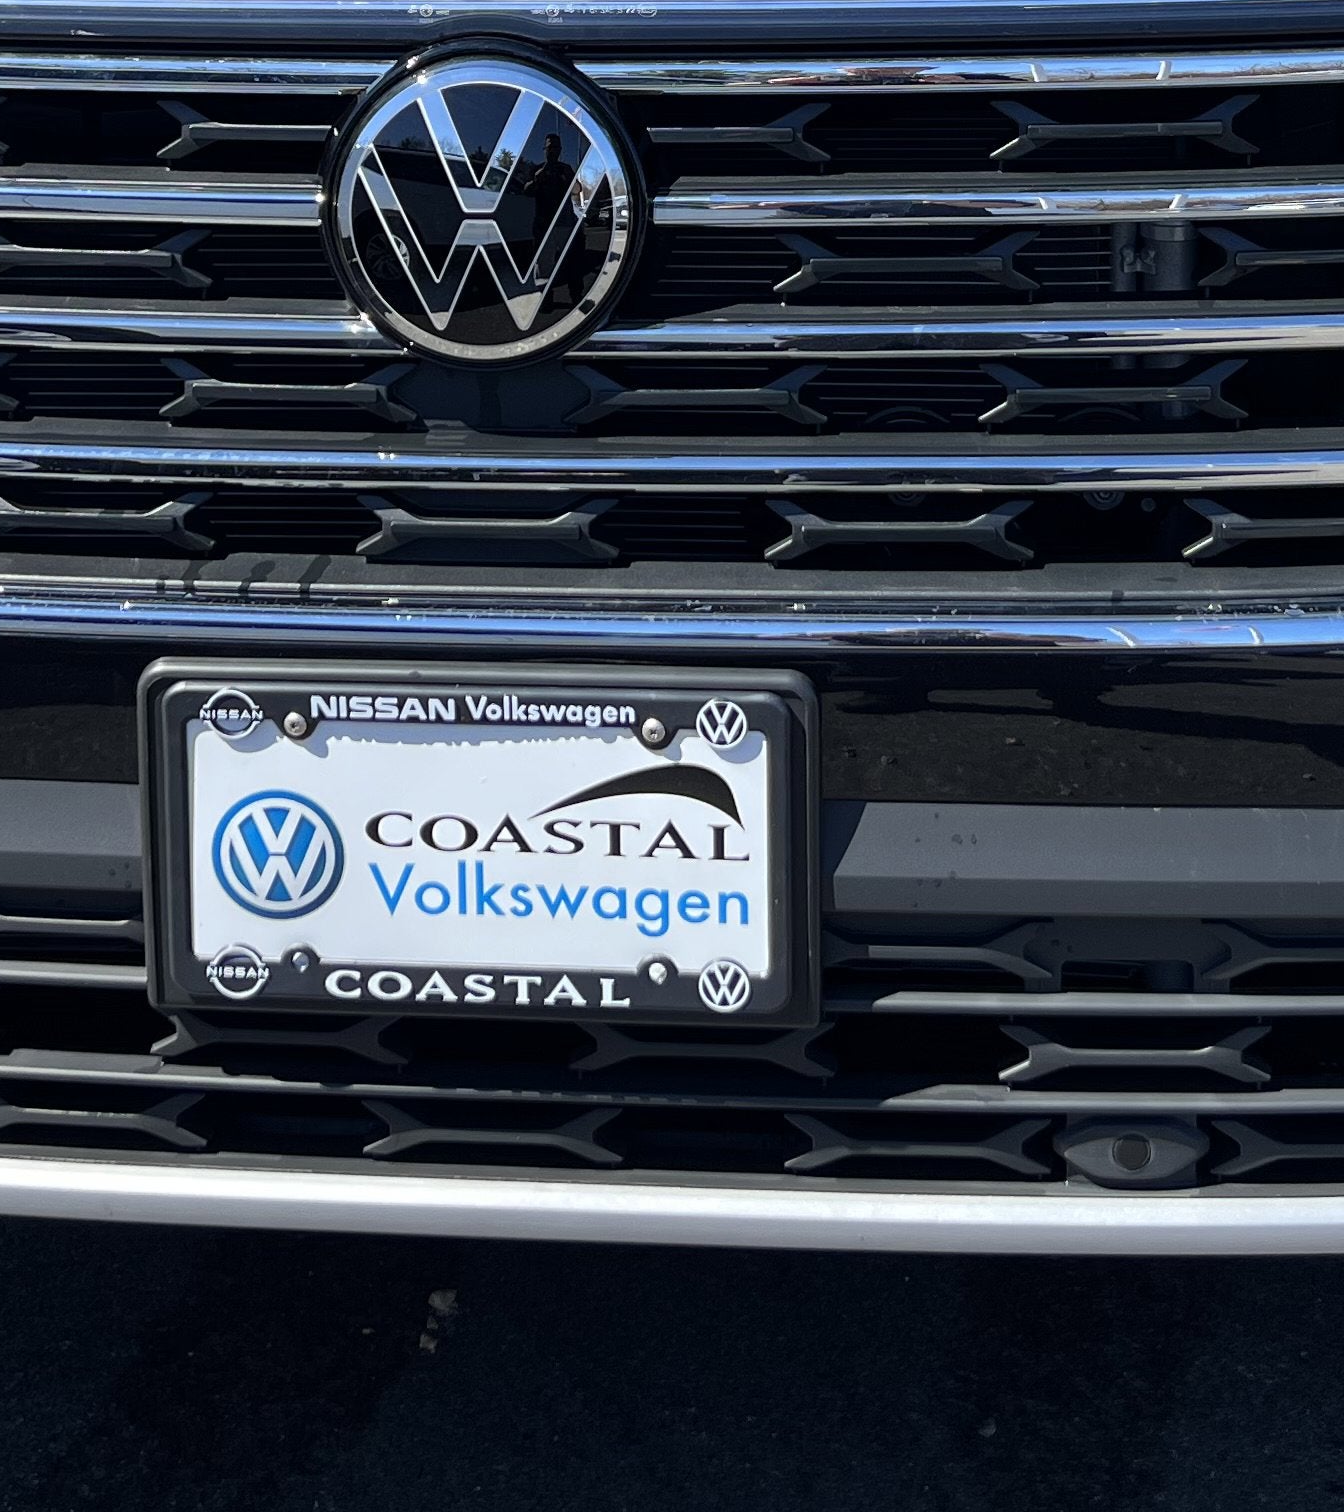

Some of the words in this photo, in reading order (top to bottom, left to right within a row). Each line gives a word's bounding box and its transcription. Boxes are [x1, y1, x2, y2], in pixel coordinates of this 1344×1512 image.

[350, 78, 616, 340] VW
[199, 708, 263, 721] NISSAN
[310, 694, 456, 721] NISSAN
[464, 694, 636, 727] Volkswagen
[697, 700, 746, 748] VW
[218, 795, 338, 913] VW
[364, 809, 750, 861] COASTAL
[367, 859, 749, 937] Volkswagen
[205, 965, 270, 979] NISSAN
[324, 969, 631, 1008] COASTAL
[700, 961, 749, 1011] VW
